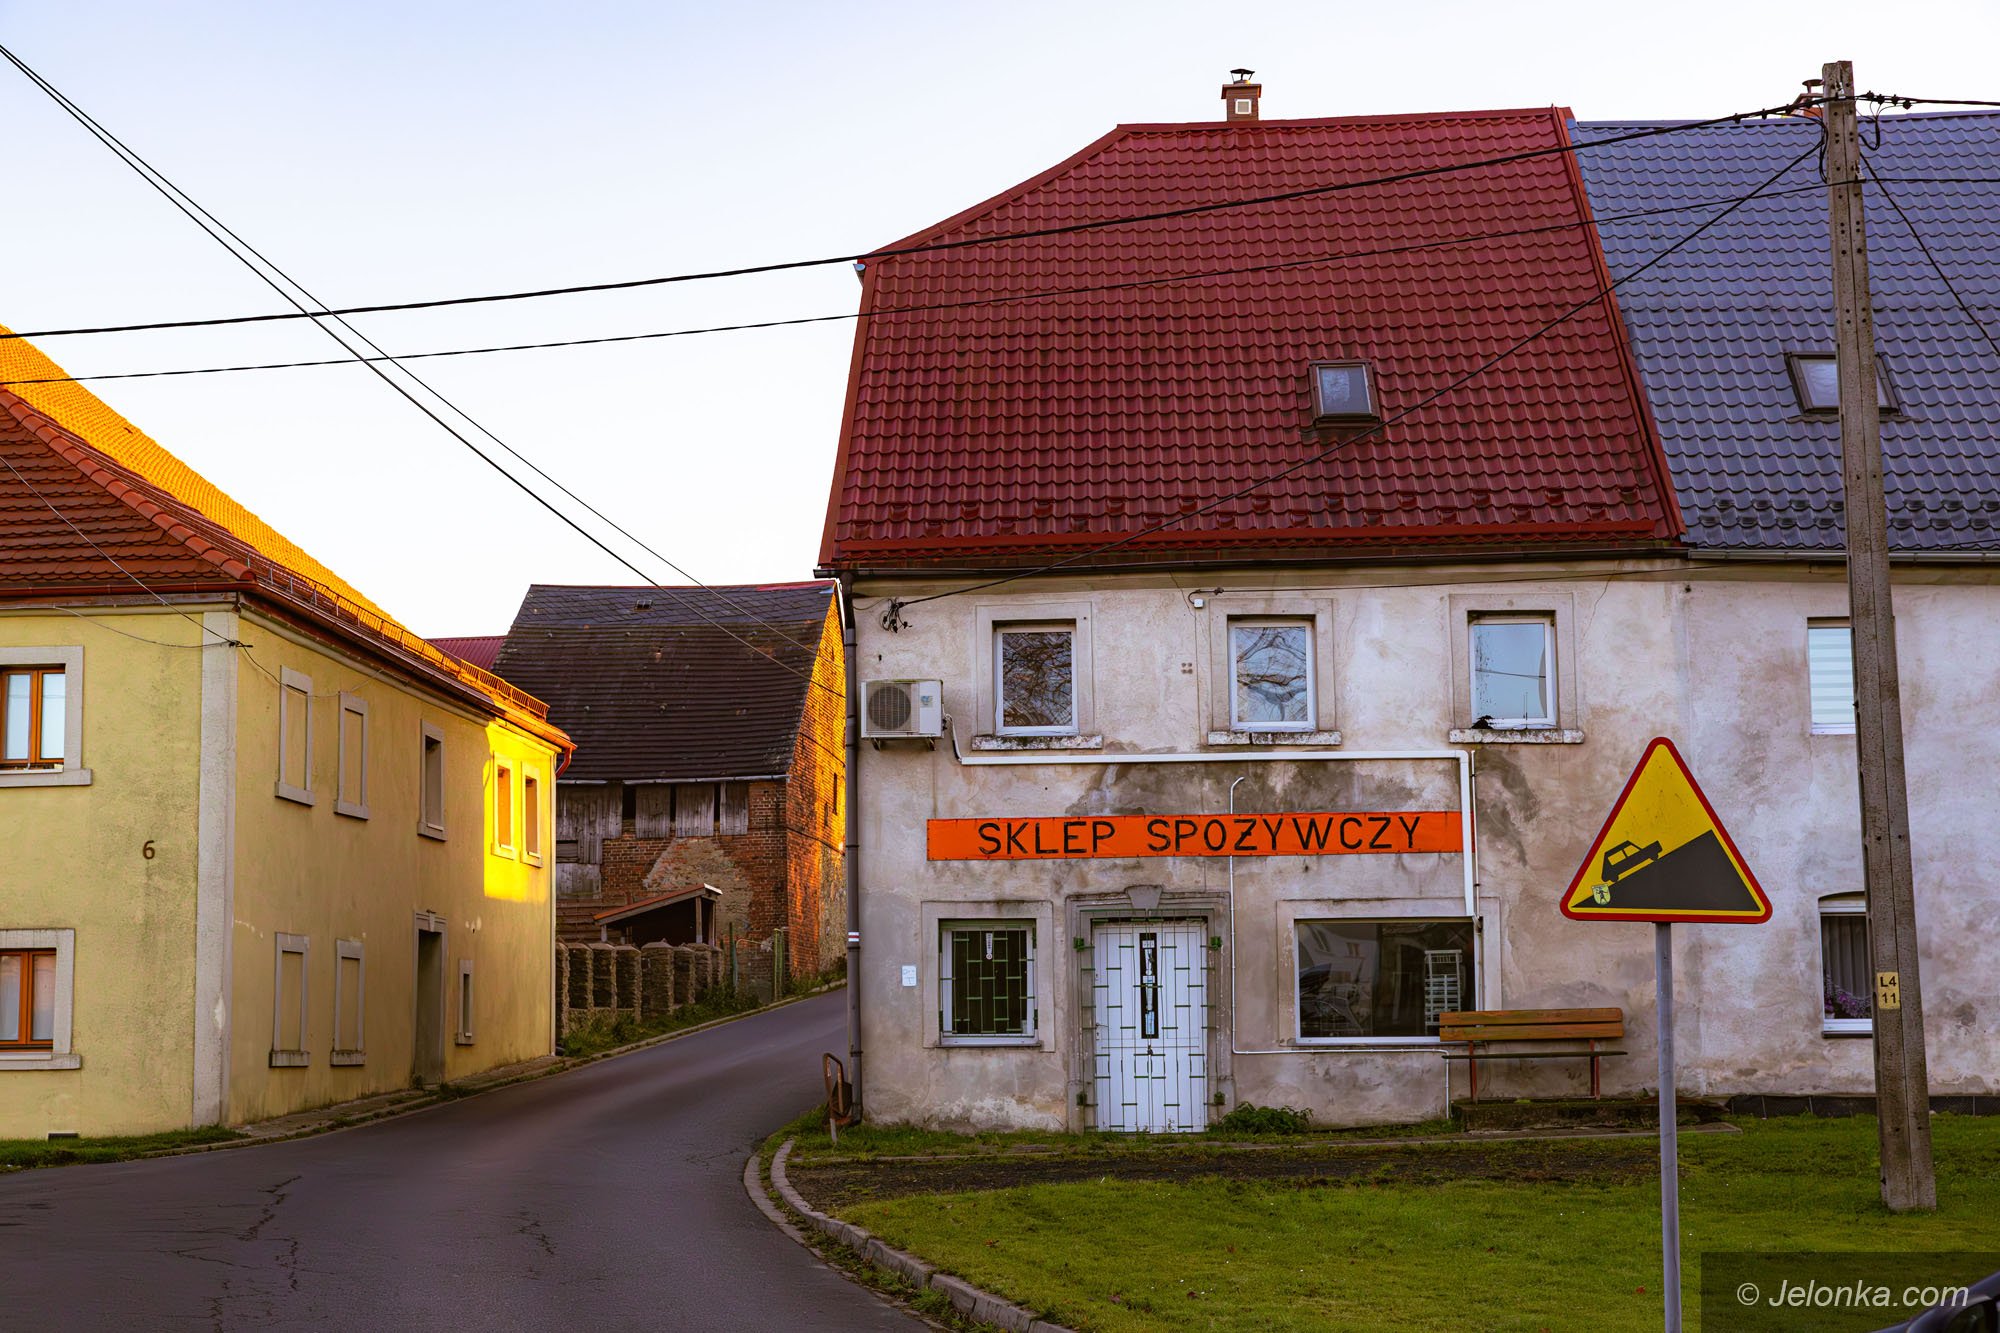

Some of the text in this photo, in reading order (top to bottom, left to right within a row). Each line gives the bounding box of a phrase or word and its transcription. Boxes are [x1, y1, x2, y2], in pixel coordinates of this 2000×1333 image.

[978, 821, 1116, 855] SKLEP
[143, 840, 155, 860] 6
[1880, 976, 1897, 988] L4
[1882, 993, 1896, 1004] 11
